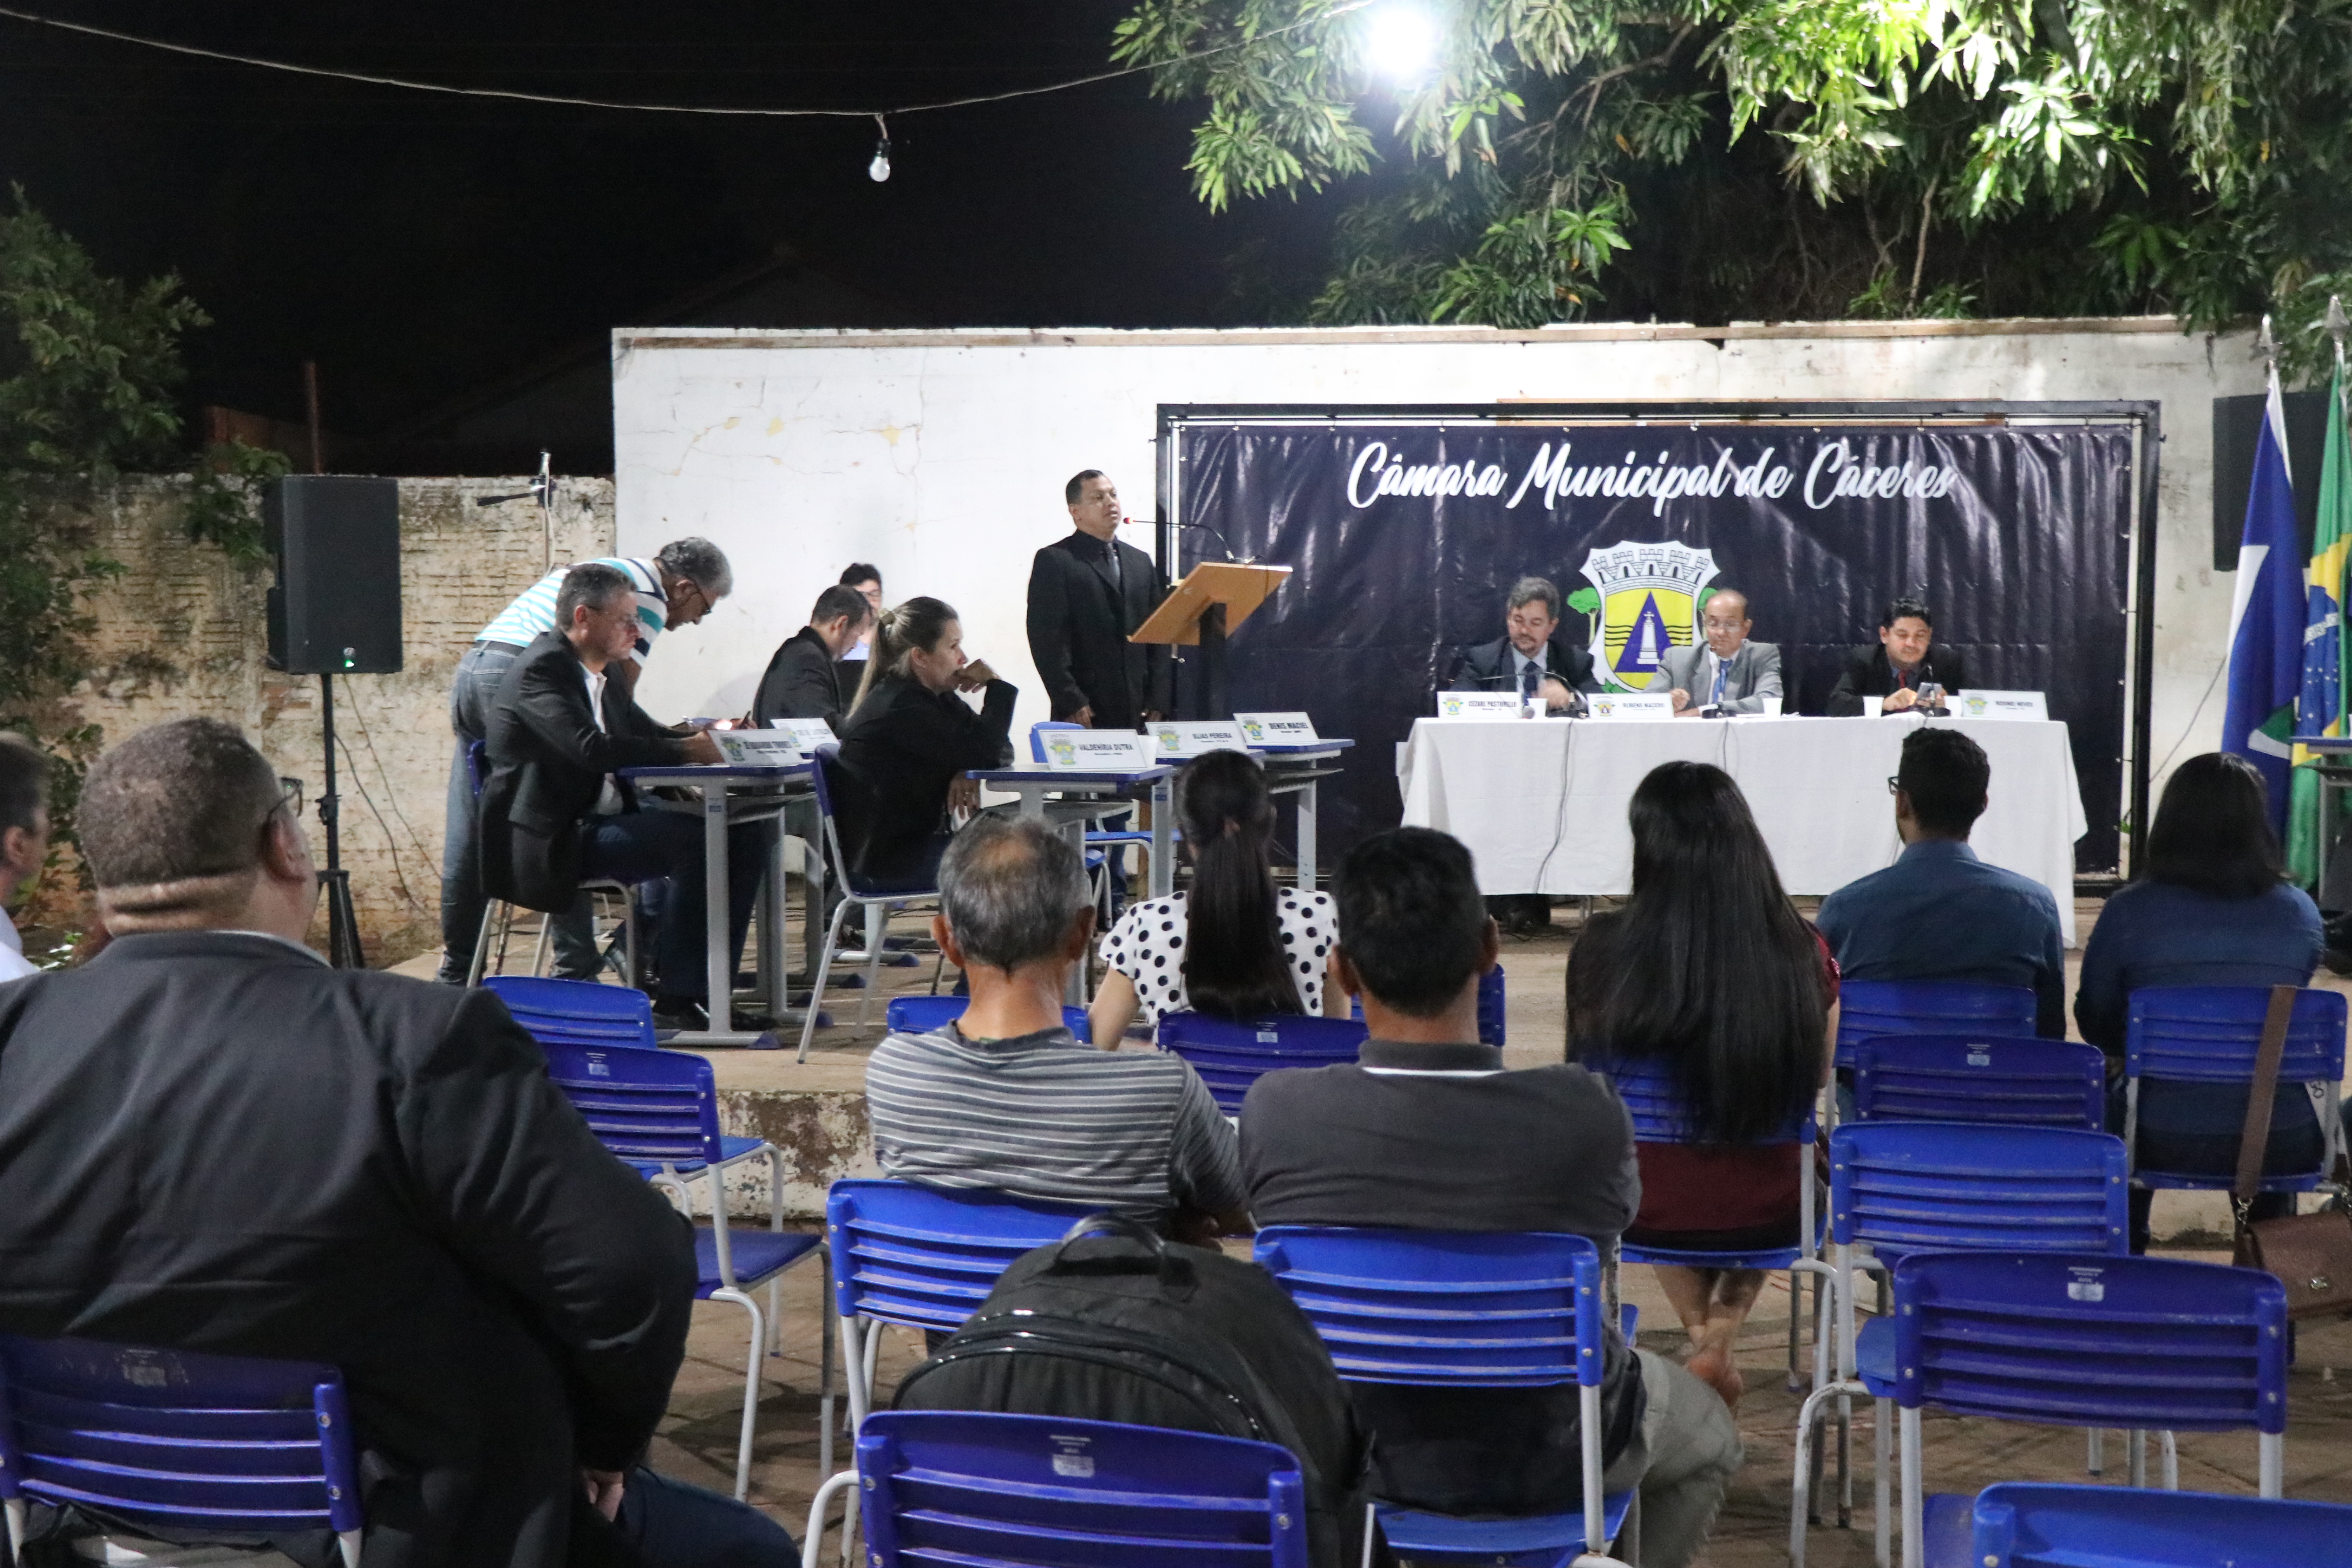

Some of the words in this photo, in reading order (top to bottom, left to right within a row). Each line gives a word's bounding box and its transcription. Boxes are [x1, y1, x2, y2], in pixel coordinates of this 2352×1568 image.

[1347, 442, 1508, 508] Câmara
[1505, 443, 1733, 517] Municipal
[1733, 447, 1794, 499] de
[1804, 442, 1958, 509] Cáceres
